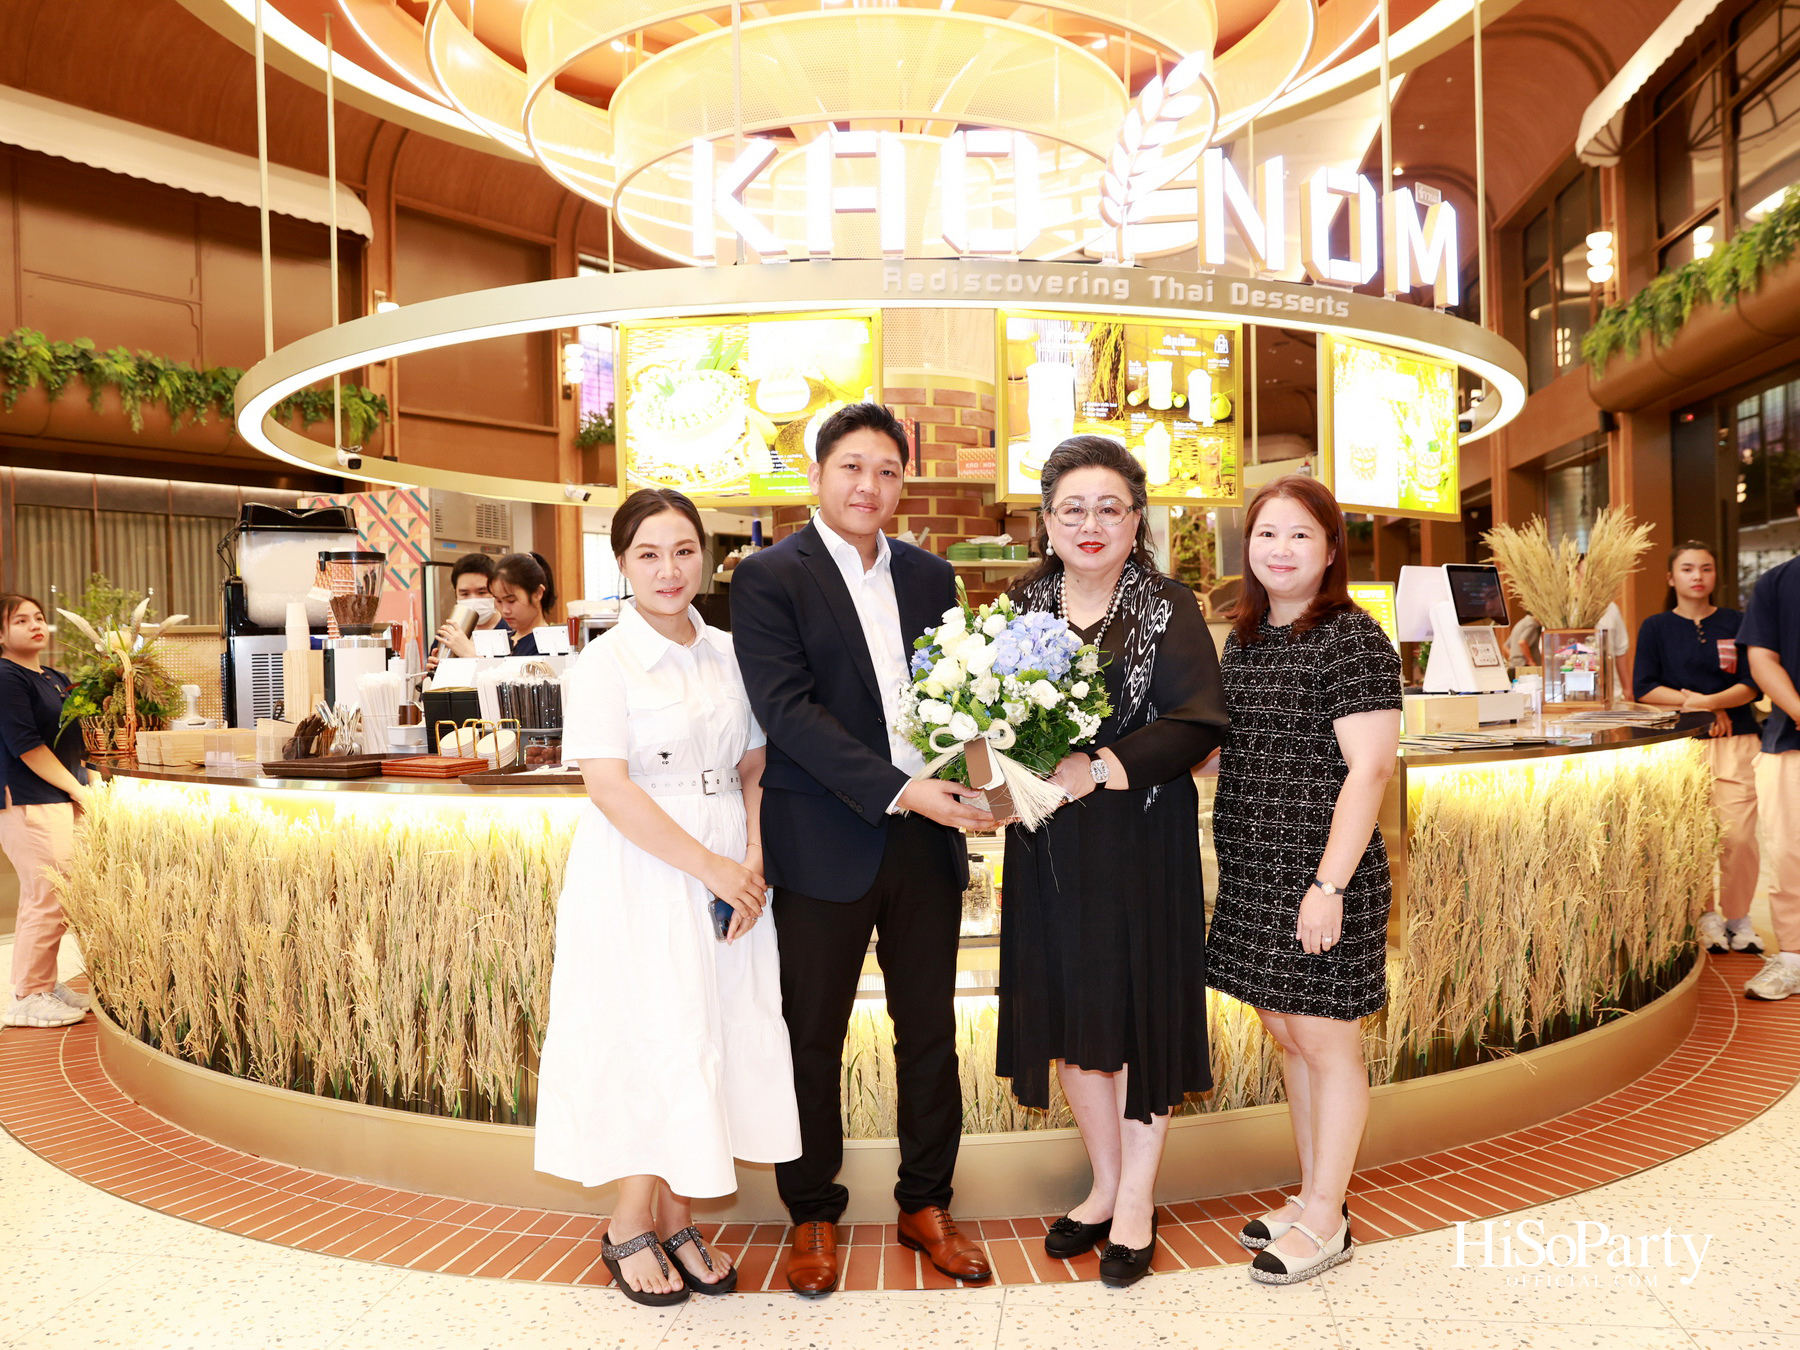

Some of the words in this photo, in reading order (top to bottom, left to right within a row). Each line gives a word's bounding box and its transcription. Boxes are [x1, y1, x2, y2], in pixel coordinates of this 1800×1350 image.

[693, 130, 1041, 256] KAO
[1197, 147, 1459, 307] NOM
[883, 267, 1130, 300] Rediscovering
[1148, 275, 1214, 303] Thai
[1231, 282, 1350, 318] Desserts
